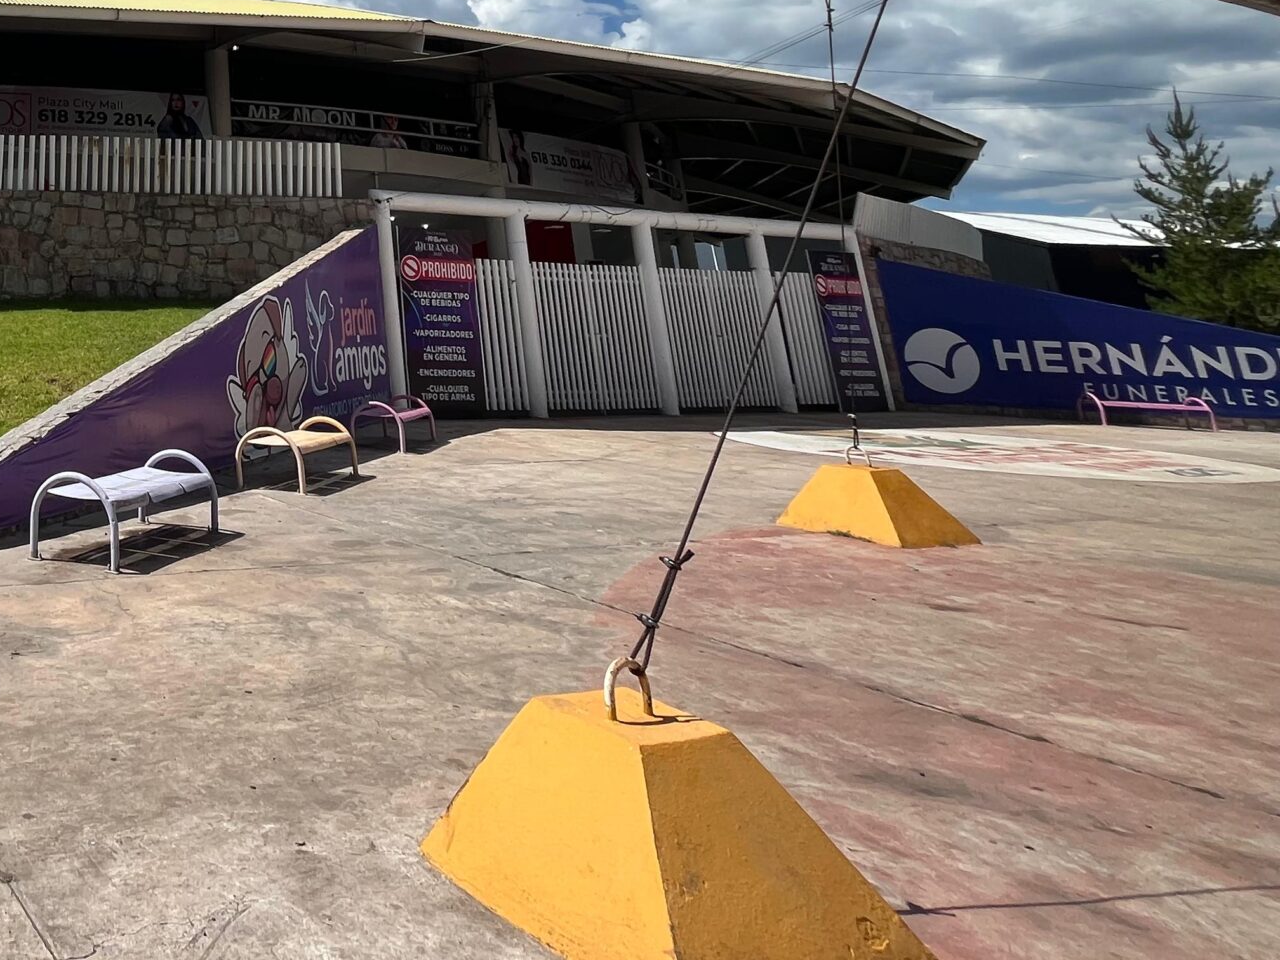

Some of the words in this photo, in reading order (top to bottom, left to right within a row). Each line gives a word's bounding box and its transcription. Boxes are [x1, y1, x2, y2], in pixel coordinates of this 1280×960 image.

[38, 96, 70, 108] Plaza
[73, 98, 97, 110] City
[100, 99, 124, 110] Mall
[37, 109, 69, 124] 618
[74, 110, 108, 125] 329
[113, 113, 156, 128] 2814
[247, 104, 281, 120] MR
[292, 106, 356, 127] MOON
[531, 151, 549, 165] 618
[550, 154, 568, 168] 330
[421, 261, 473, 280] PROHIBIDO
[420, 298, 430, 306] DE
[431, 298, 461, 308] BEBIDAS
[453, 292, 470, 301] TIPO
[335, 334, 387, 390] amigos
[423, 353, 434, 361] EN
[434, 353, 468, 362] GENERAL
[992, 335, 1280, 382] HERNÁND
[421, 392, 439, 401] TIPO
[439, 393, 449, 401] DE
[450, 393, 476, 402] ARMAS
[1083, 382, 1280, 407] FUNERALES
